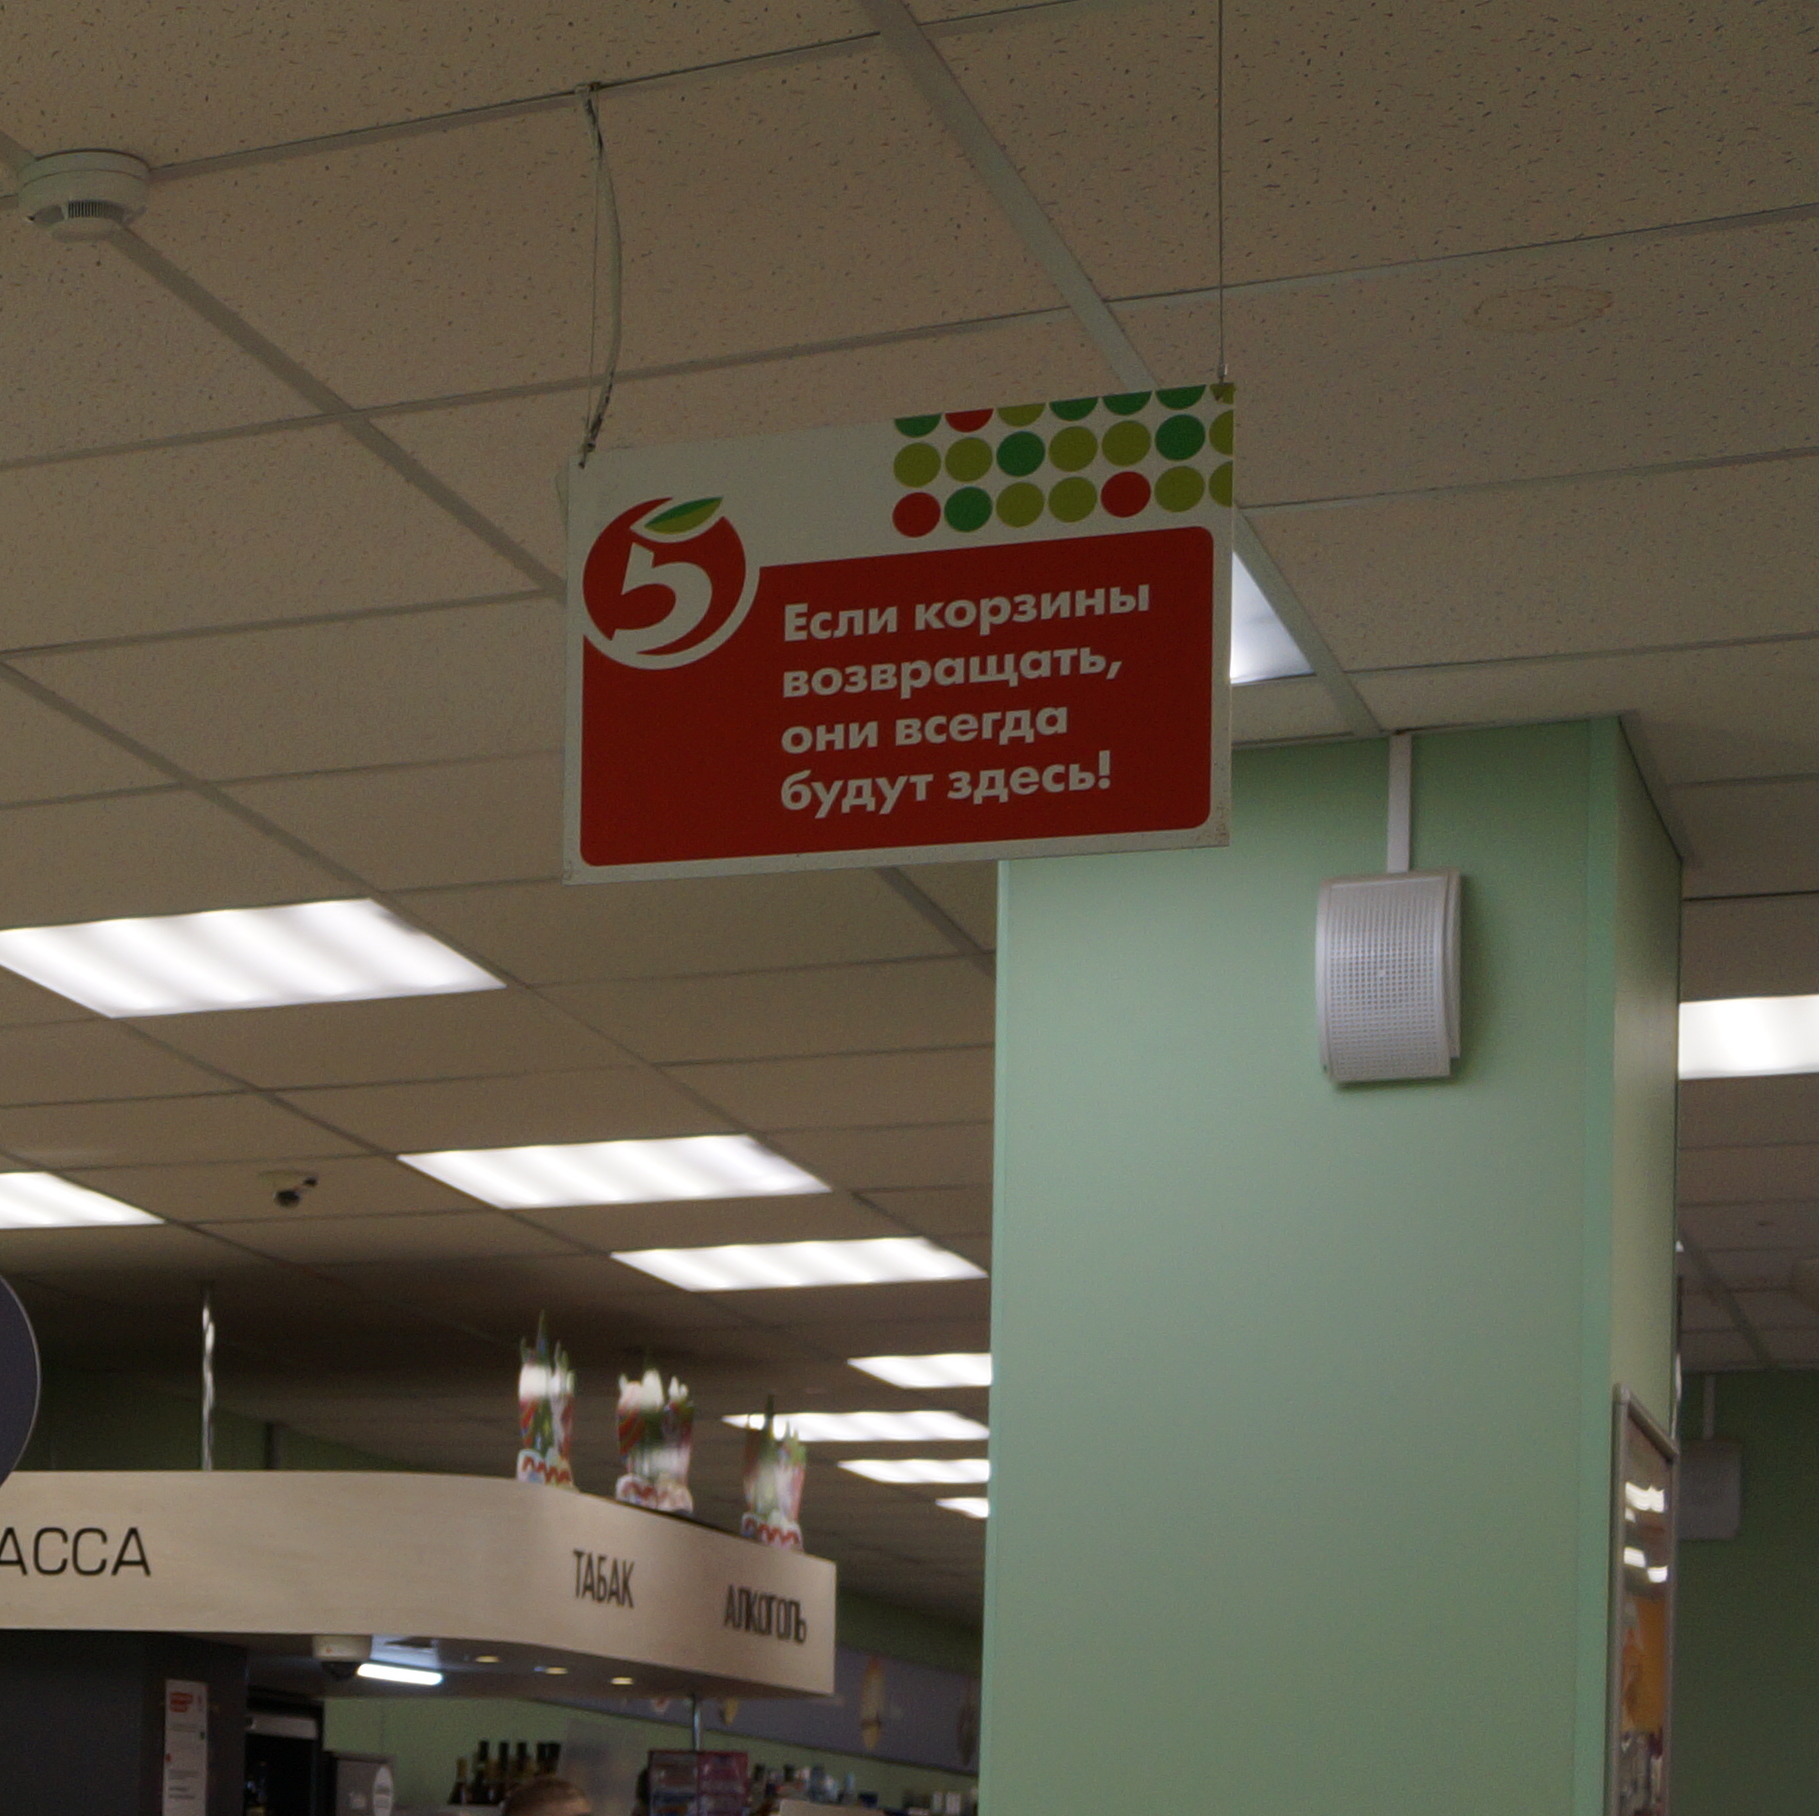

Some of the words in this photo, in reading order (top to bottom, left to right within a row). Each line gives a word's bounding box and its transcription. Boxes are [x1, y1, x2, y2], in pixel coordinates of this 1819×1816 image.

[782, 602, 898, 643] Если
[914, 584, 1150, 633] корзины
[783, 645, 1122, 701] возвращать,
[781, 718, 878, 754] они
[895, 705, 1068, 749] всегда
[781, 770, 933, 819] будут
[946, 751, 1111, 805] здесь!
[573, 1548, 634, 1609] ТАБАК
[724, 1584, 807, 1645] АЛКОГОЛЬ
